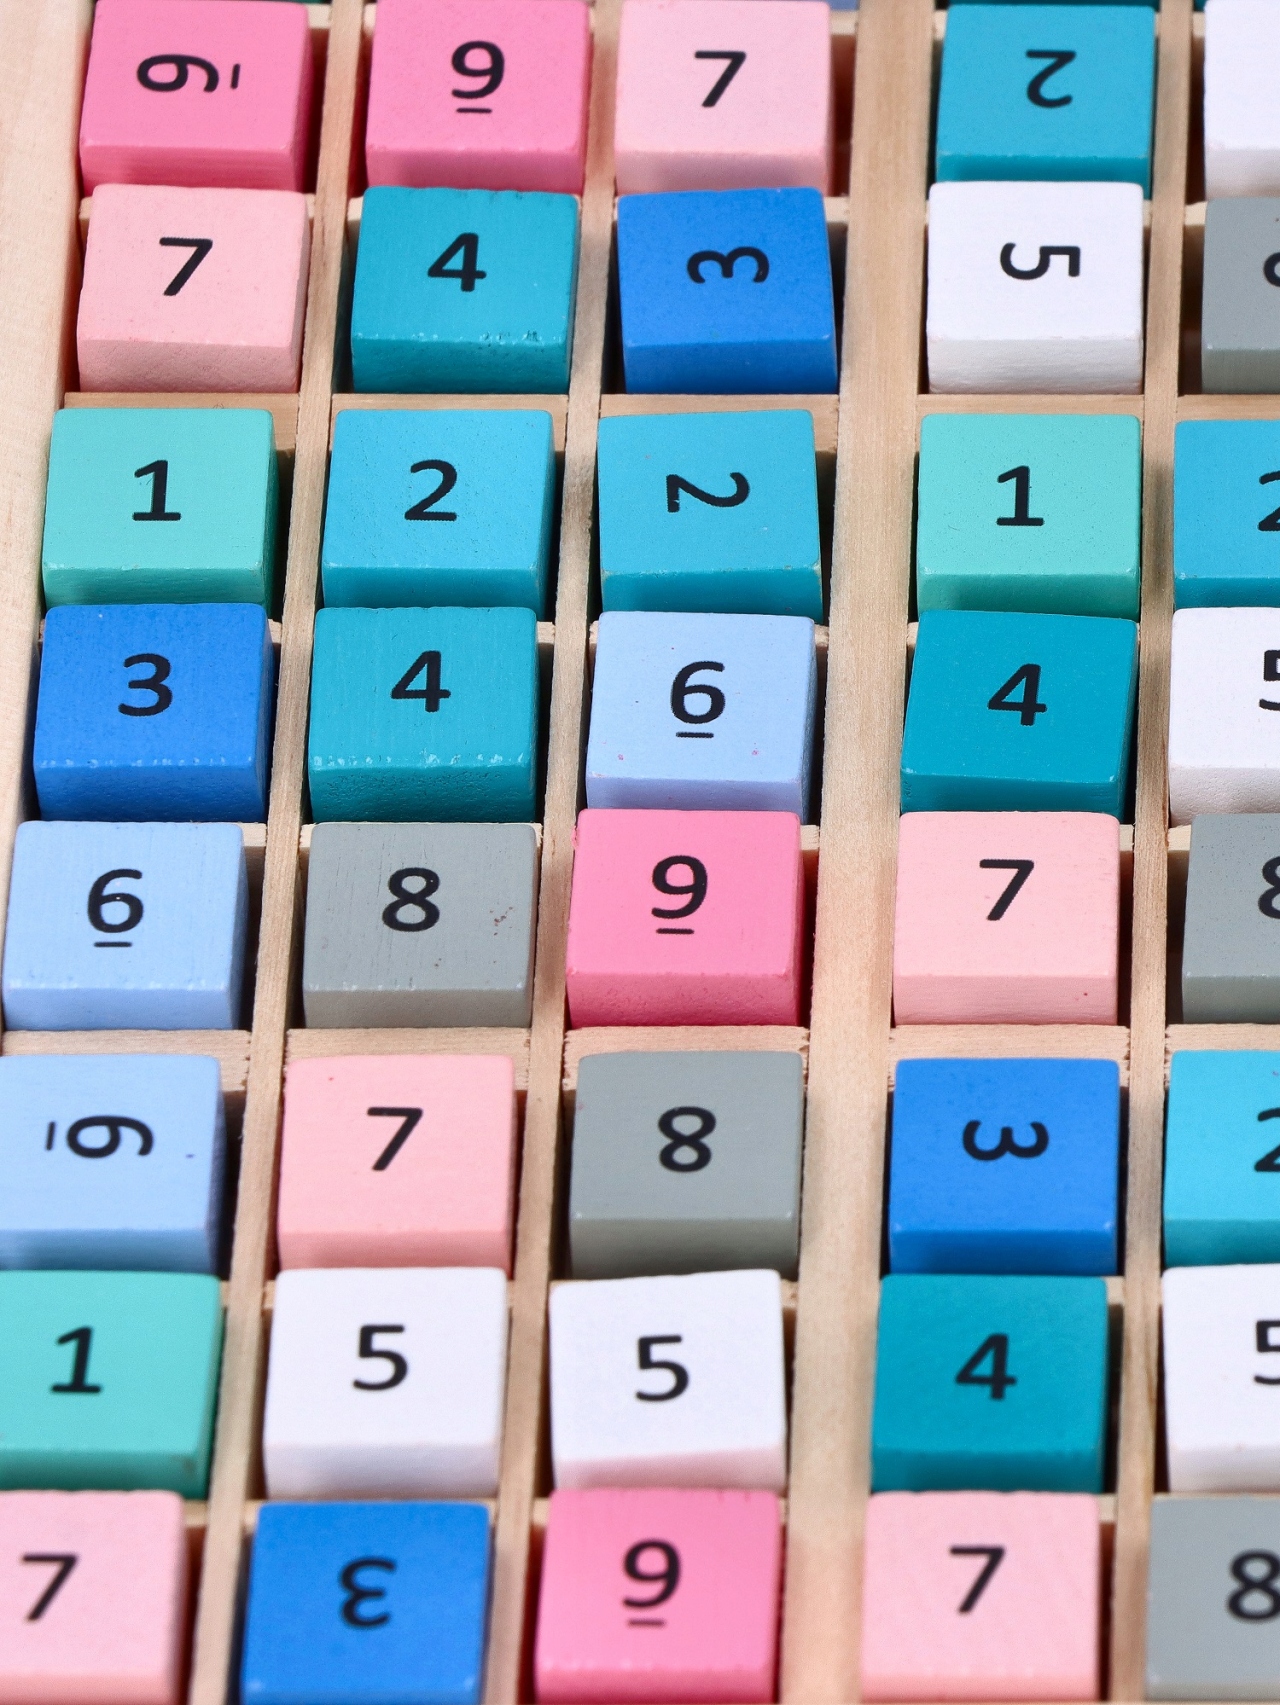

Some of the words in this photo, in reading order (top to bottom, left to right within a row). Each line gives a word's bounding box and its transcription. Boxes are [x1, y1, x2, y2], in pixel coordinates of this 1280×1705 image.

[452, 41, 504, 113] 9
[695, 51, 746, 107] 7
[1026, 51, 1075, 108] 2
[160, 237, 212, 296] 7
[428, 233, 486, 292] 4
[687, 247, 769, 283] 3
[1000, 243, 1080, 280] 5
[133, 460, 181, 521] 1
[405, 460, 457, 521] 2
[666, 473, 749, 512] 2
[997, 466, 1043, 526] 1
[119, 654, 172, 716] 3
[391, 651, 451, 712] 4
[671, 661, 725, 738] 6
[988, 664, 1047, 726] 4
[88, 869, 143, 947] 6
[382, 868, 439, 932] 8
[652, 856, 707, 934] 9
[980, 859, 1034, 920] 7
[368, 1107, 422, 1170] 7
[658, 1107, 715, 1172] 8
[963, 1121, 1048, 1161] 3
[52, 1328, 100, 1393] 1
[354, 1325, 407, 1390] 5
[636, 1336, 688, 1401] 5
[956, 1334, 1016, 1399] 4
[24, 1555, 77, 1620] 7
[341, 1559, 394, 1628] 3
[625, 1541, 680, 1627] 9
[951, 1547, 1004, 1612] 7
